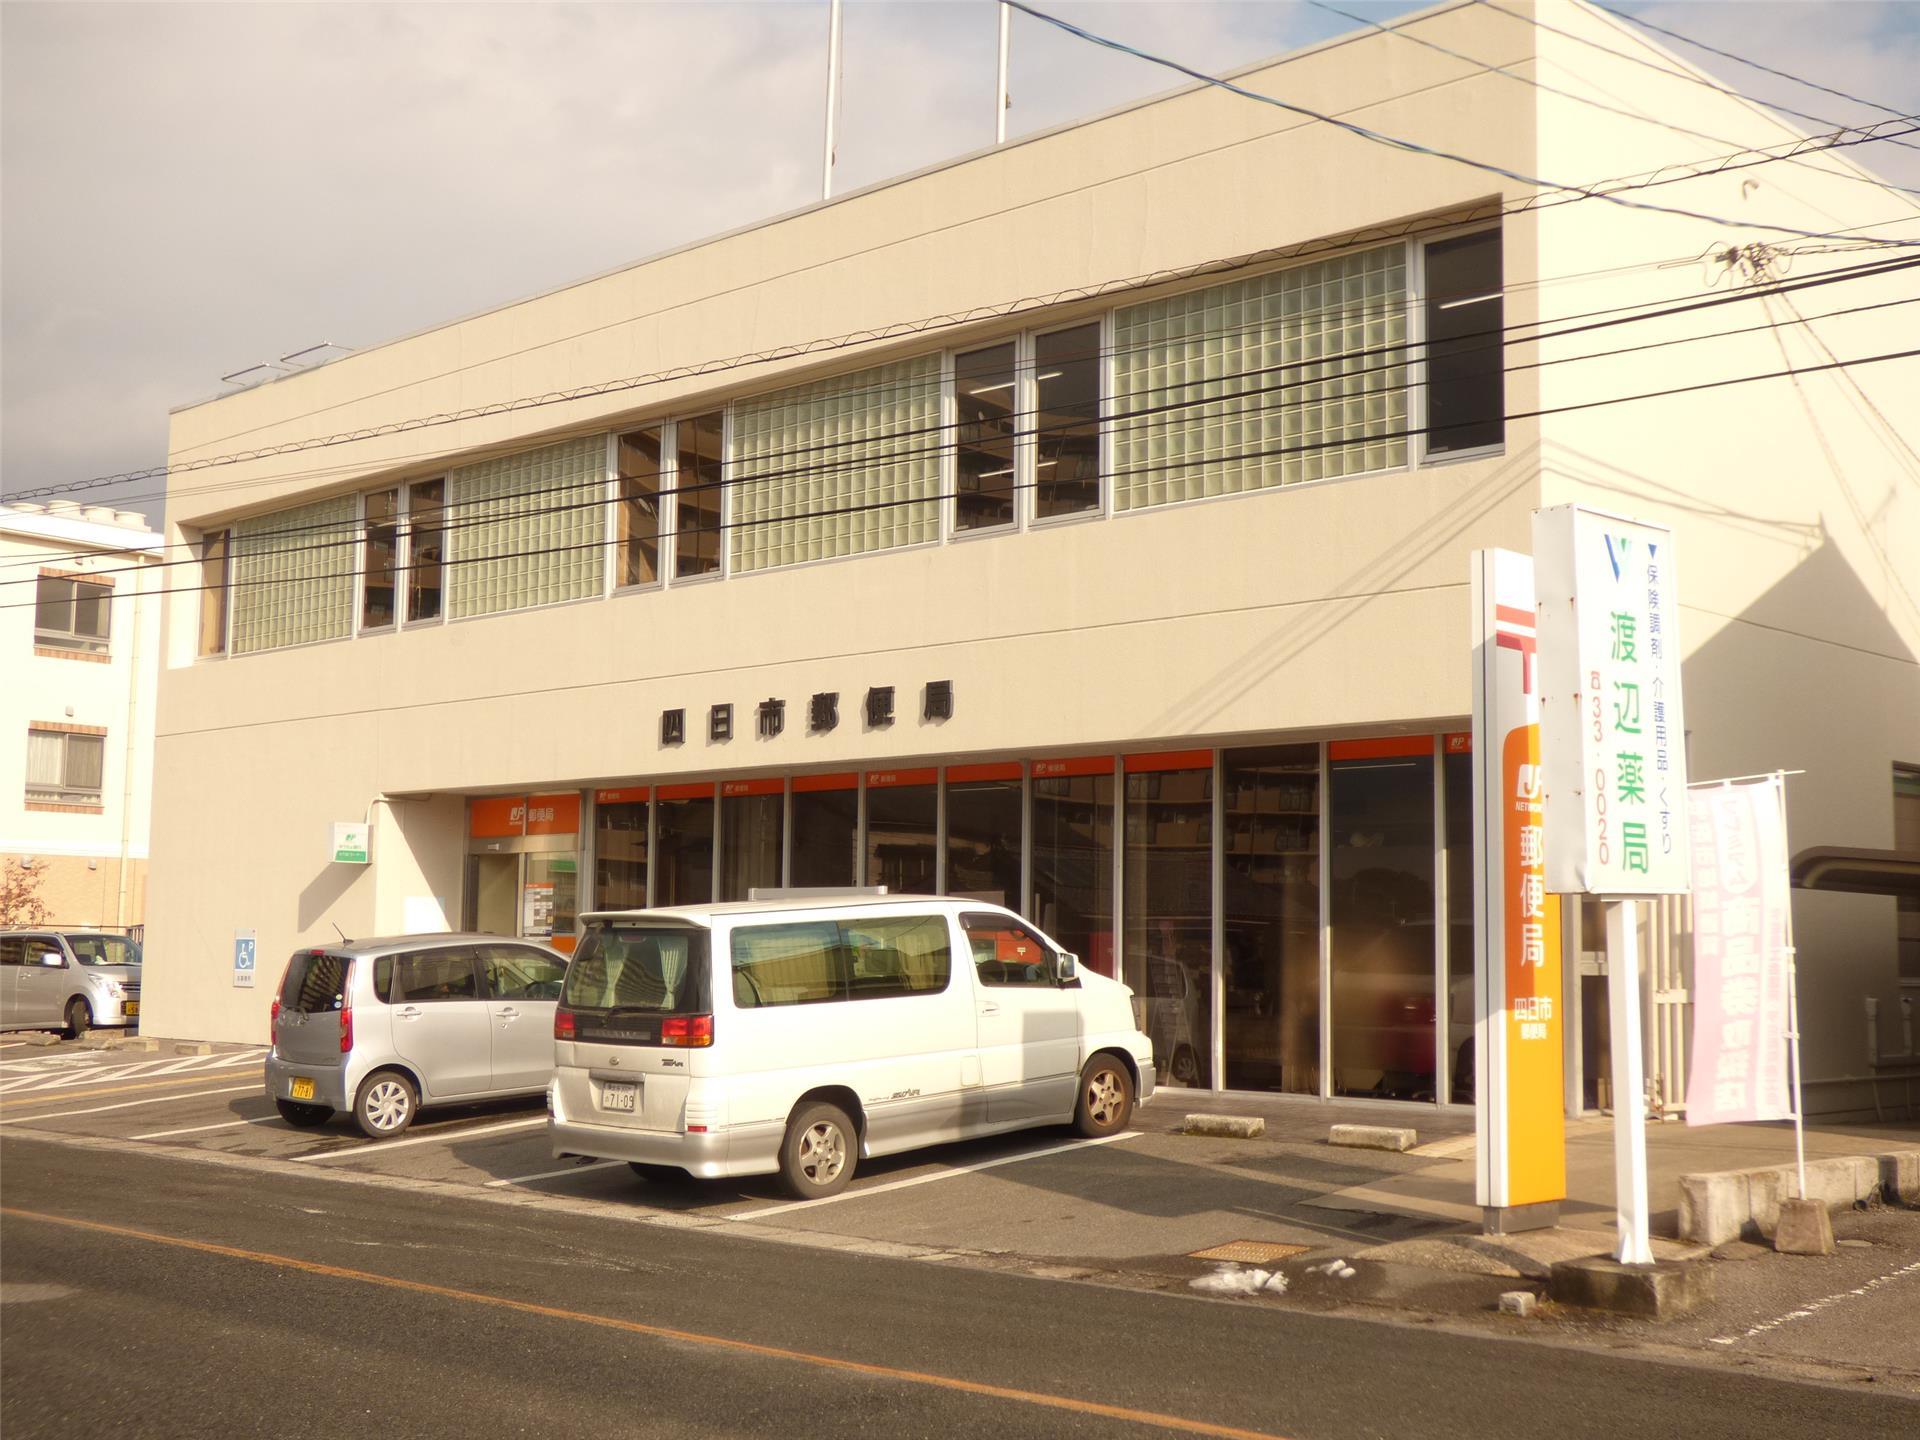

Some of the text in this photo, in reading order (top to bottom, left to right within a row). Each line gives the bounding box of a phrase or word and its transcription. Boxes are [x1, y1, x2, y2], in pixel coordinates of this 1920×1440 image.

[661, 679, 954, 745] 四日市郵便局
[1610, 610, 1649, 874] 渡辺薬局
[528, 807, 554, 823] 郵便局
[1520, 825, 1545, 968] 郵便局
[1514, 996, 1553, 1021] 四日市
